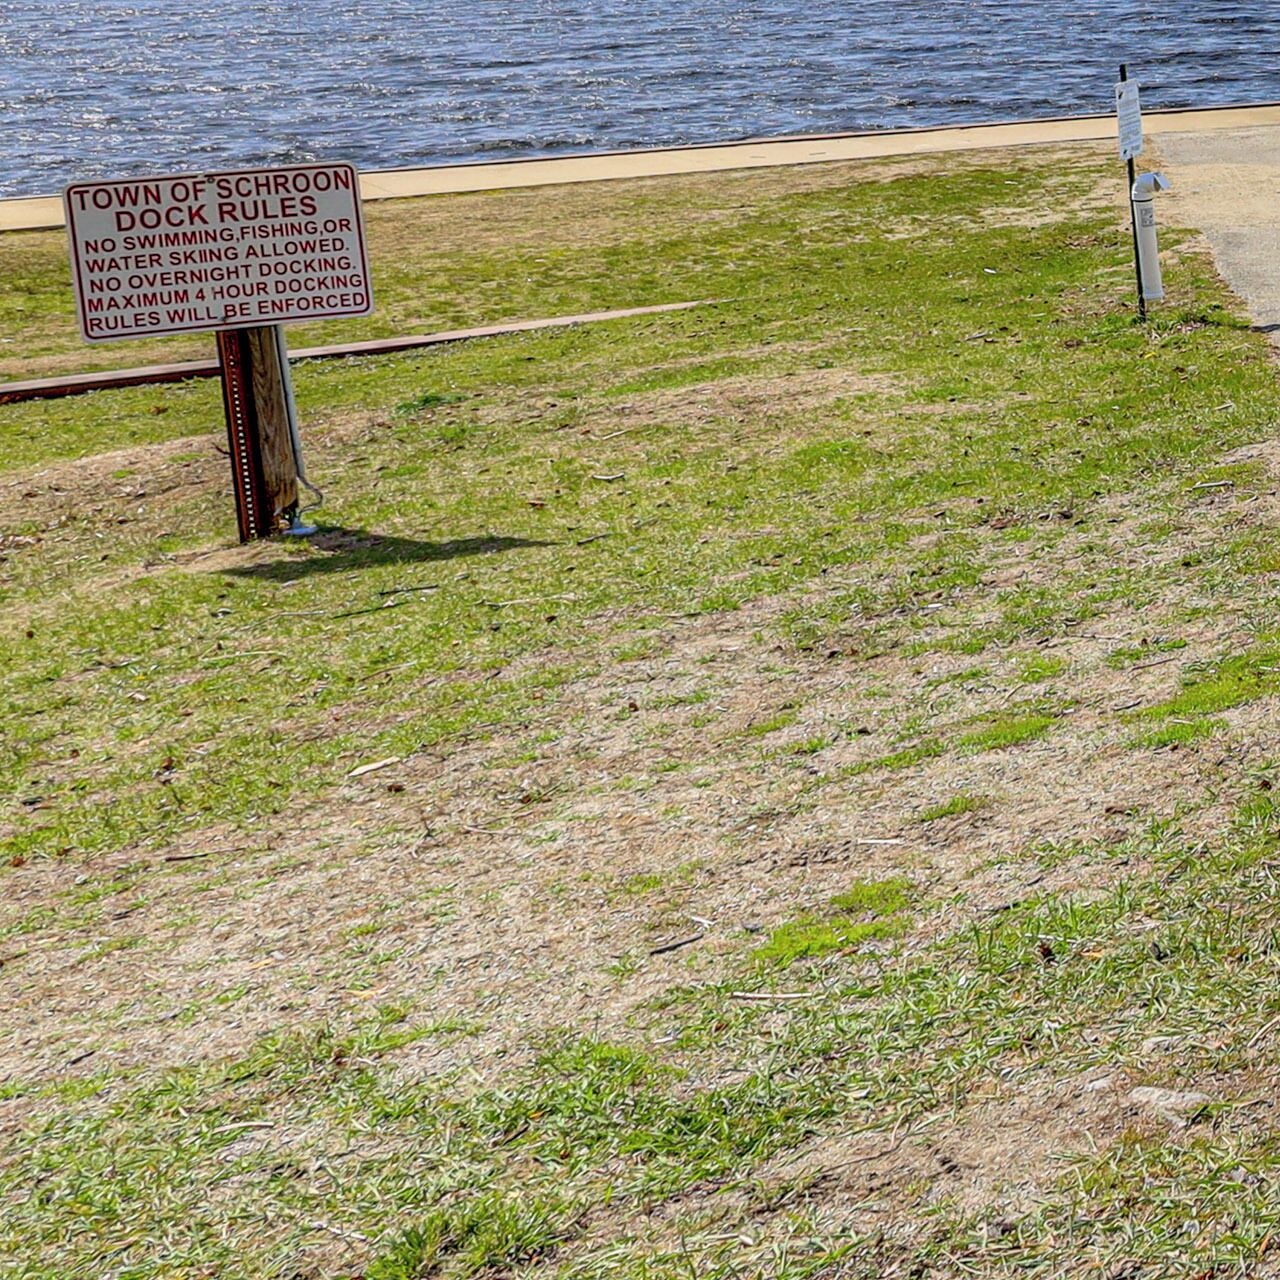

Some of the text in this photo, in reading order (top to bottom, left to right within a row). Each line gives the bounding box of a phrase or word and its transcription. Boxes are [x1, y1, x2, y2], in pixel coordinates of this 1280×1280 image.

[73, 169, 350, 210] TOWN OF SCHROON
[115, 195, 317, 232] DOCK RULES
[85, 238, 116, 254] NO
[85, 238, 350, 274] WATER SKIING ALLOWED.
[90, 256, 357, 293] NO OVERNIGHT DOCKING.
[88, 274, 362, 313] MAXIMUM 4 HOUR DOCKING
[89, 292, 365, 332] RULES WILL BE ENFORCED
